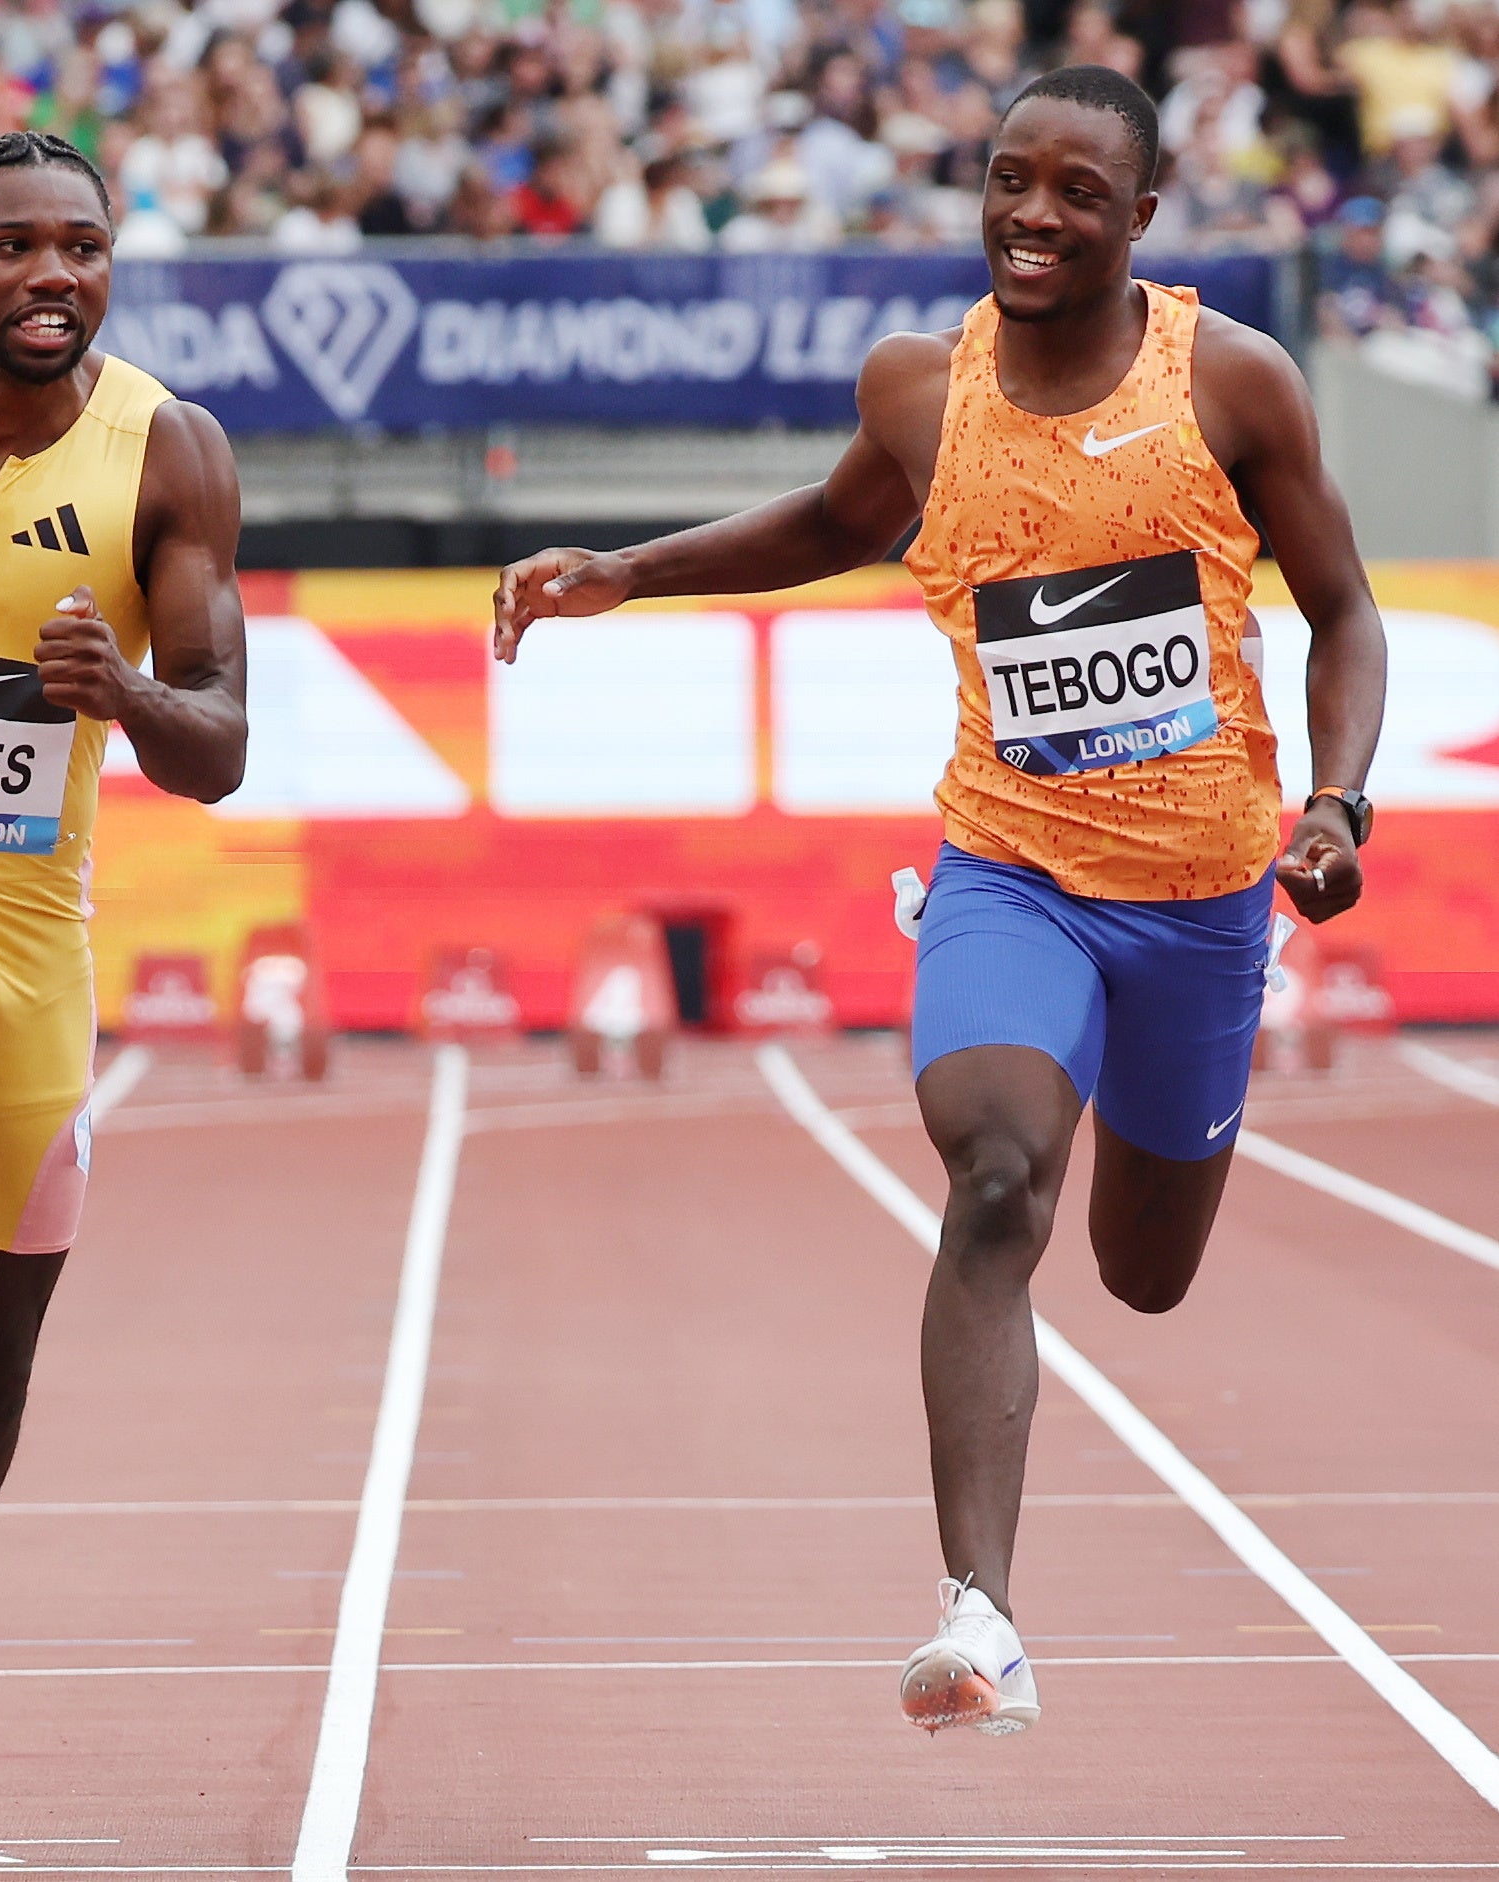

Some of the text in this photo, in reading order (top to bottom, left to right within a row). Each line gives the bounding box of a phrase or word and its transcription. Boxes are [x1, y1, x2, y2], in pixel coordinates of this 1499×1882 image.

[418, 300, 762, 385] DIAMOND
[992, 634, 1199, 717] TEBOGO
[1079, 718, 1191, 761] LONDON
